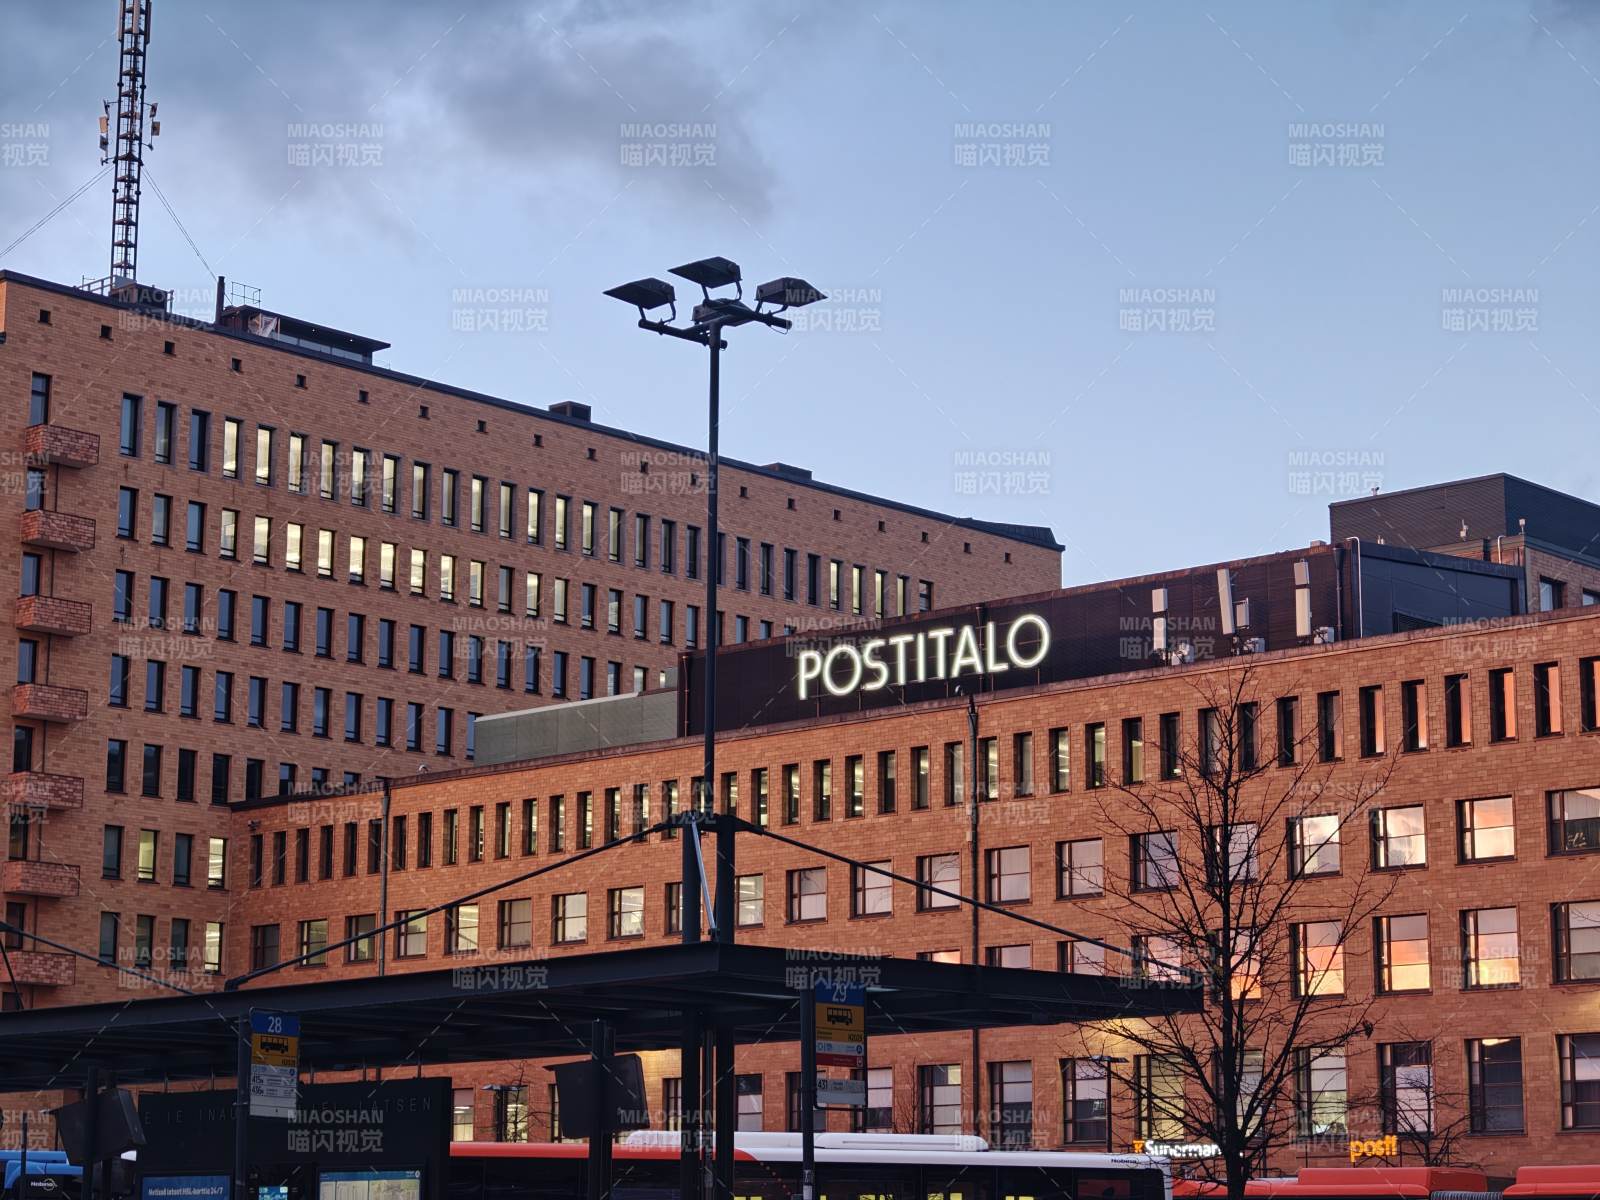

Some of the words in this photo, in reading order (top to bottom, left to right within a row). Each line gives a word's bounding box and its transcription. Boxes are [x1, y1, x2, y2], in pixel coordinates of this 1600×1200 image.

[798, 614, 1051, 700] POSTITALO
[831, 983, 847, 1002] 29
[267, 1016, 282, 1033] 28
[1350, 1134, 1398, 1162] posti
